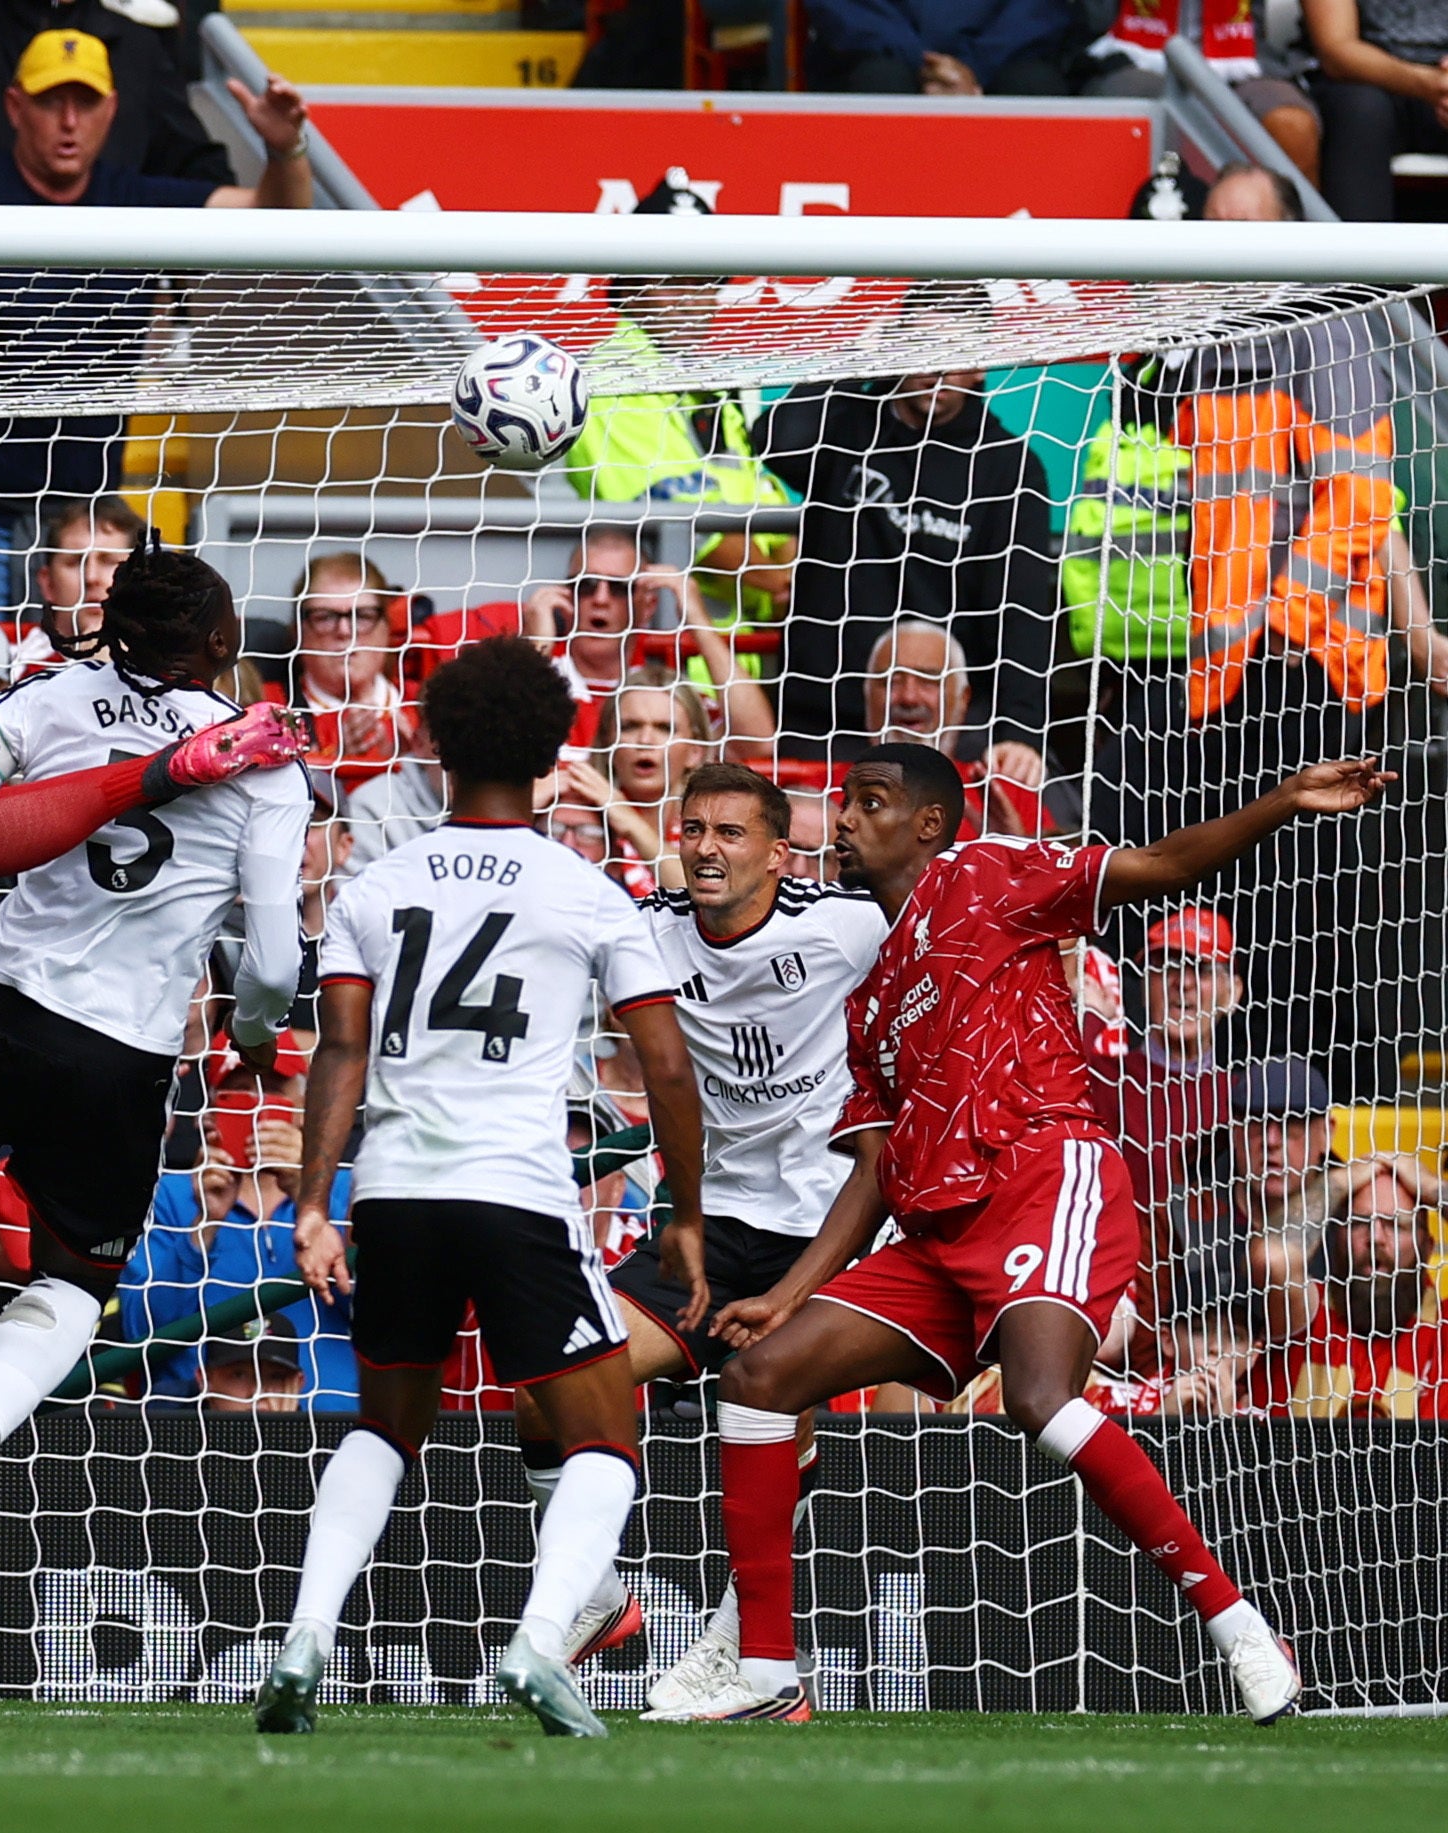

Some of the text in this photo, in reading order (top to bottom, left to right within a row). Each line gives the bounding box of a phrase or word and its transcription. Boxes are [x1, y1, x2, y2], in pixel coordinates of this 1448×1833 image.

[516, 57, 557, 86] 16
[428, 854, 522, 886] BOBB
[380, 906, 530, 1063] 14
[704, 1069, 827, 1103] ClickHouse
[1003, 1243, 1044, 1294] 9
